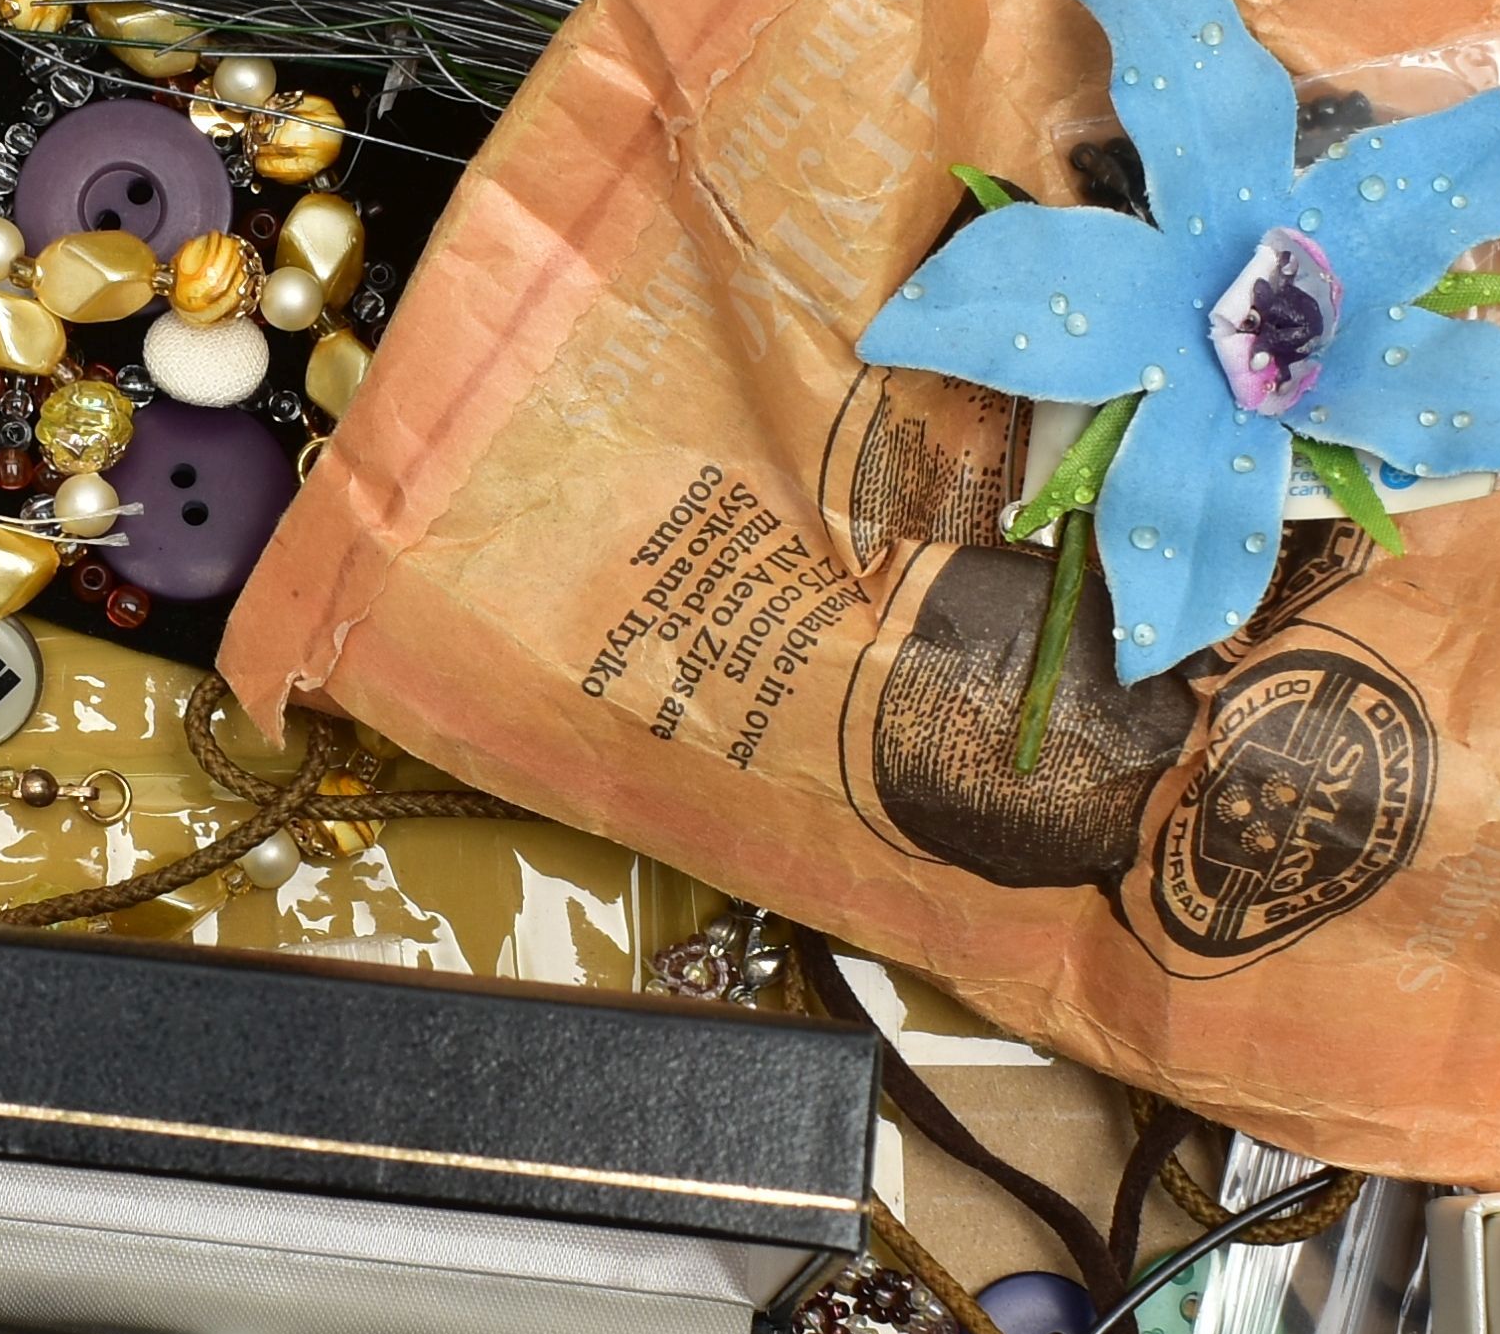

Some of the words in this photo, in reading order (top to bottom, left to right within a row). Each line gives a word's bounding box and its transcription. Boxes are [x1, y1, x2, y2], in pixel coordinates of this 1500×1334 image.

[629, 464, 724, 568] colours.
[686, 481, 760, 558] Sylko
[764, 534, 811, 574] All
[641, 556, 694, 612] and
[681, 508, 782, 615] matched
[710, 561, 775, 627] Aero
[797, 555, 848, 595] 275
[581, 608, 659, 699] Trylko
[656, 613, 693, 643] to
[671, 624, 728, 699] Zips
[723, 584, 803, 684] colours
[772, 580, 872, 676] Available
[649, 695, 685, 742] are
[754, 674, 796, 708] in
[1205, 678, 1311, 768] COTTON
[726, 709, 770, 771] over
[1270, 736, 1365, 894] SYLKO
[1166, 818, 1210, 923] THREAD
